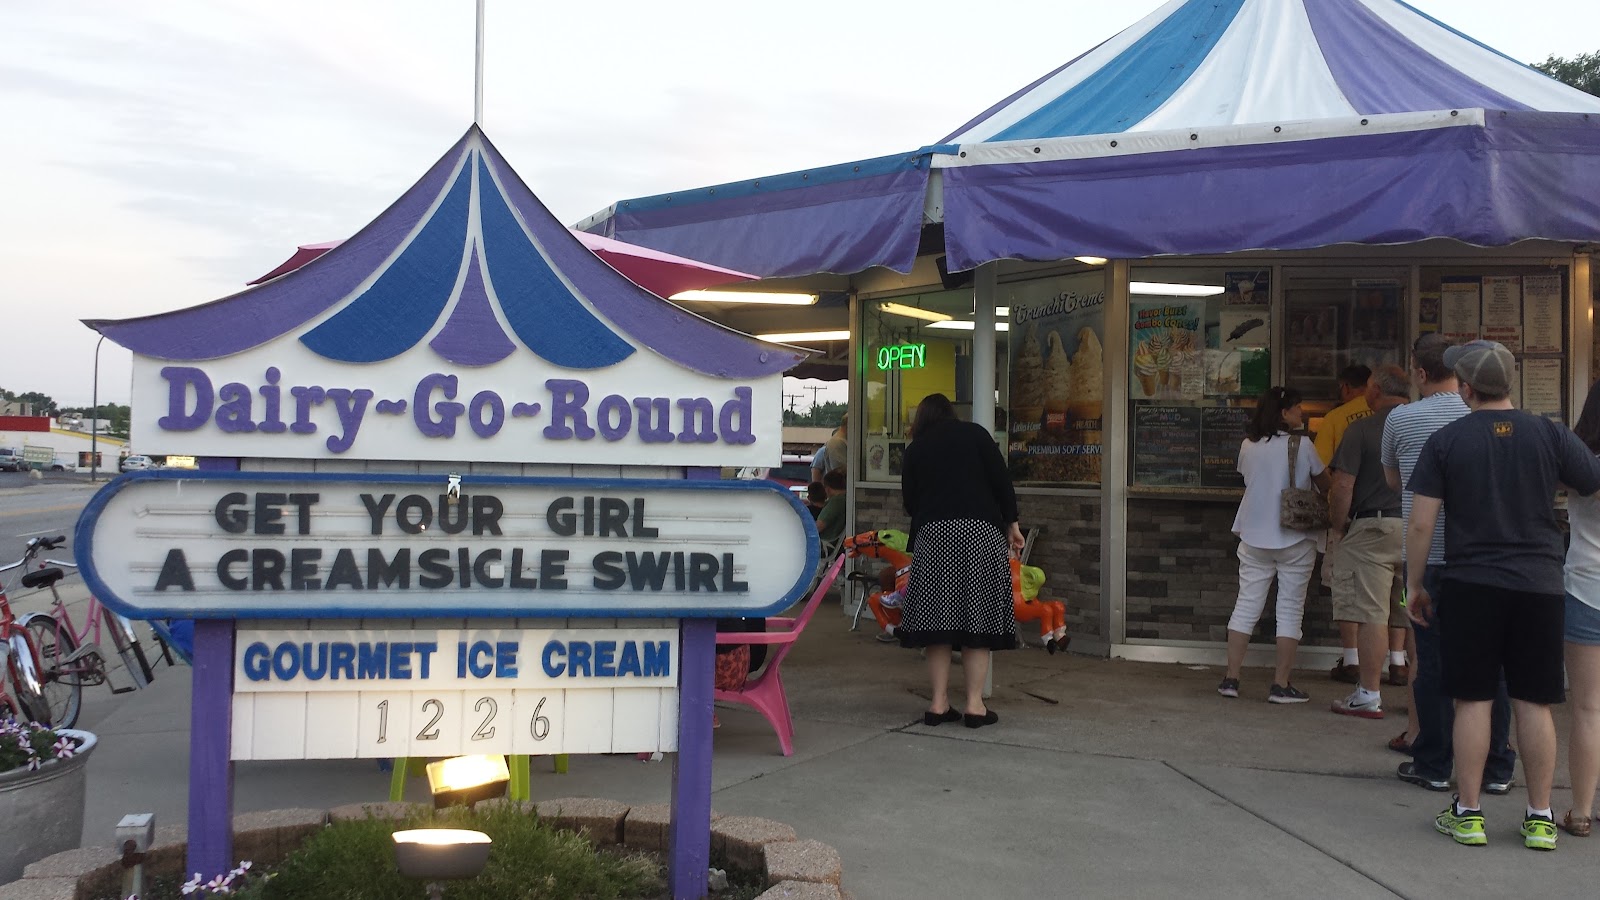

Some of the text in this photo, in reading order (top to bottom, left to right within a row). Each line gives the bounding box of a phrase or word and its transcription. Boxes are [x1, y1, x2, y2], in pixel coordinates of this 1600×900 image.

[1163, 305, 1187, 316] Burst
[1134, 317, 1199, 331] Combo Cones!
[877, 344, 926, 370] OPEN
[1028, 445, 1061, 455] PREMIUM
[1062, 445, 1080, 454] SOFT
[215, 494, 658, 538] GET YOUR GIRL
[155, 548, 749, 593] A CREAMSICLE SWIRL
[244, 641, 670, 681] GOURMET ICE CREAM
